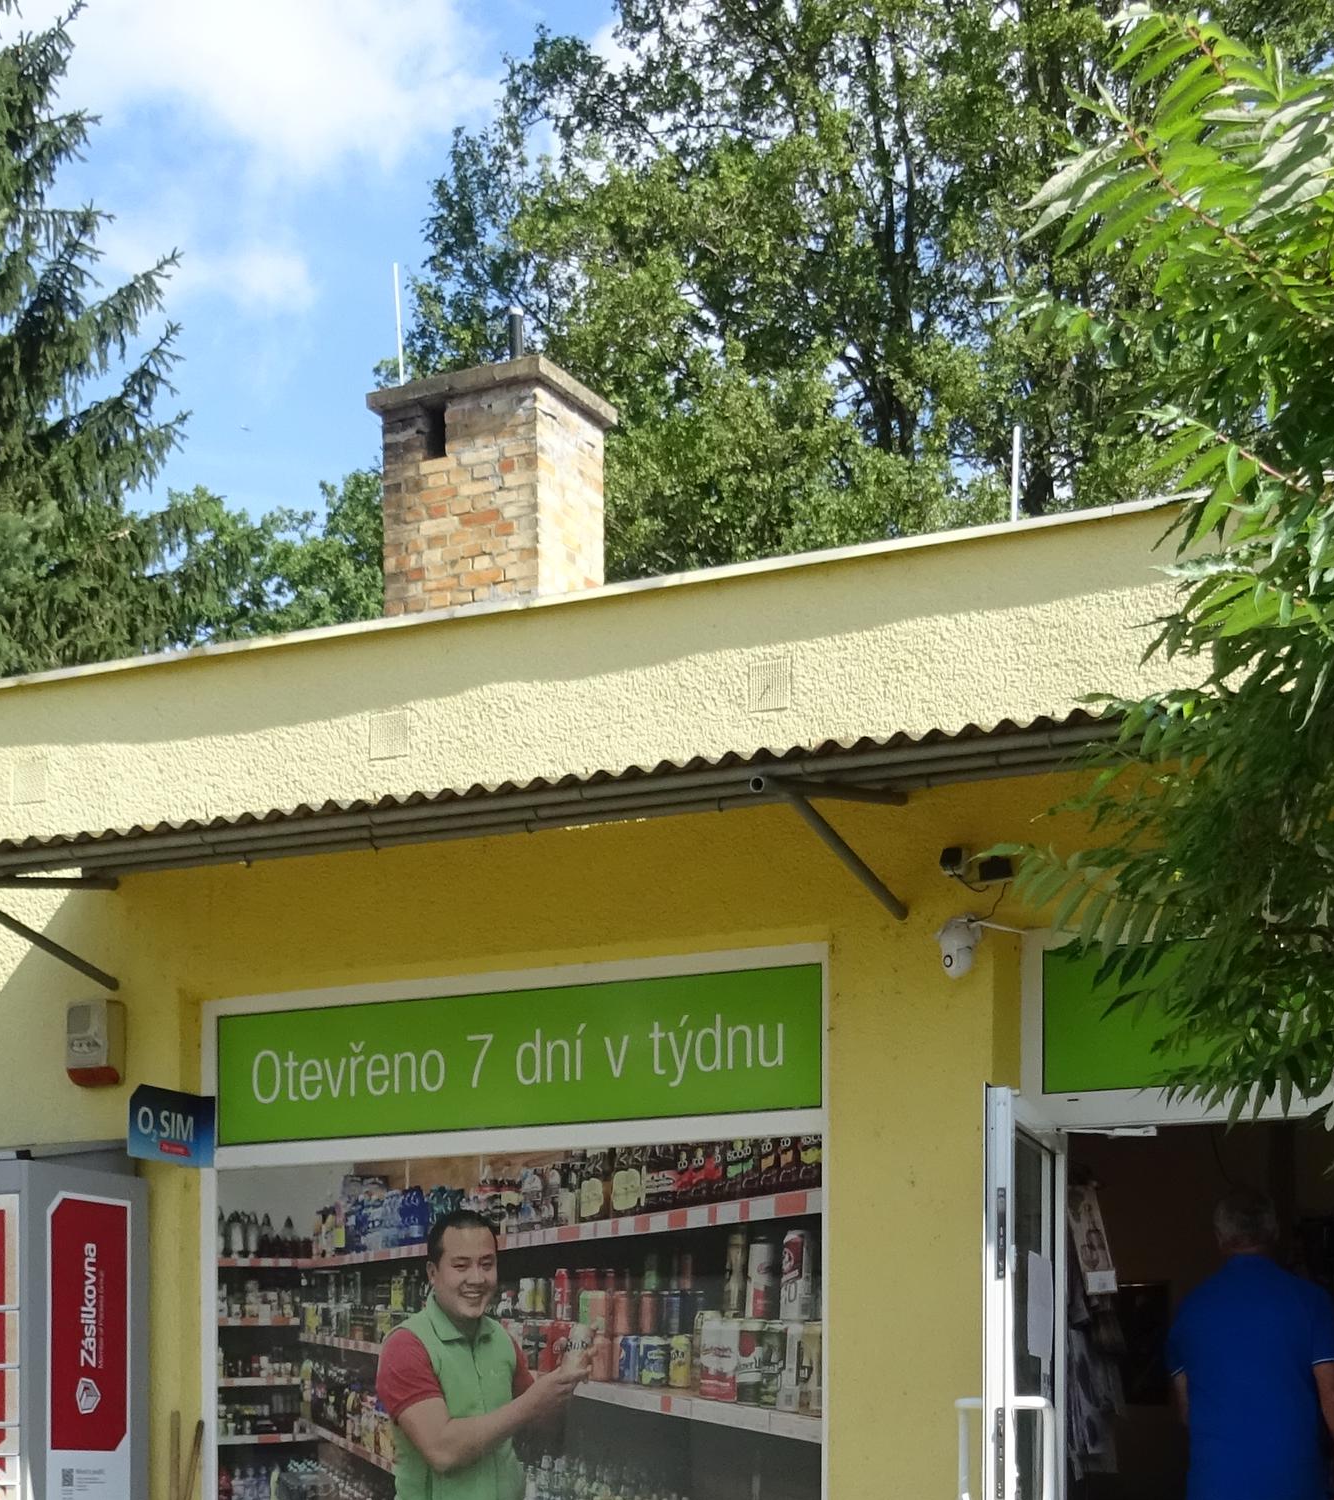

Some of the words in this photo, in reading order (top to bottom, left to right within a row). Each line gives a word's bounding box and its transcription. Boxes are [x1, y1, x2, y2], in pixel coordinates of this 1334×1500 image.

[252, 1041, 446, 1104] Otevřeno
[467, 1033, 494, 1089] 7
[516, 1022, 587, 1085] dní
[604, 1035, 630, 1078] v
[648, 1013, 785, 1087] týdnu
[159, 1110, 194, 1142] SIM
[80, 1243, 97, 1368] Zásilkovna
